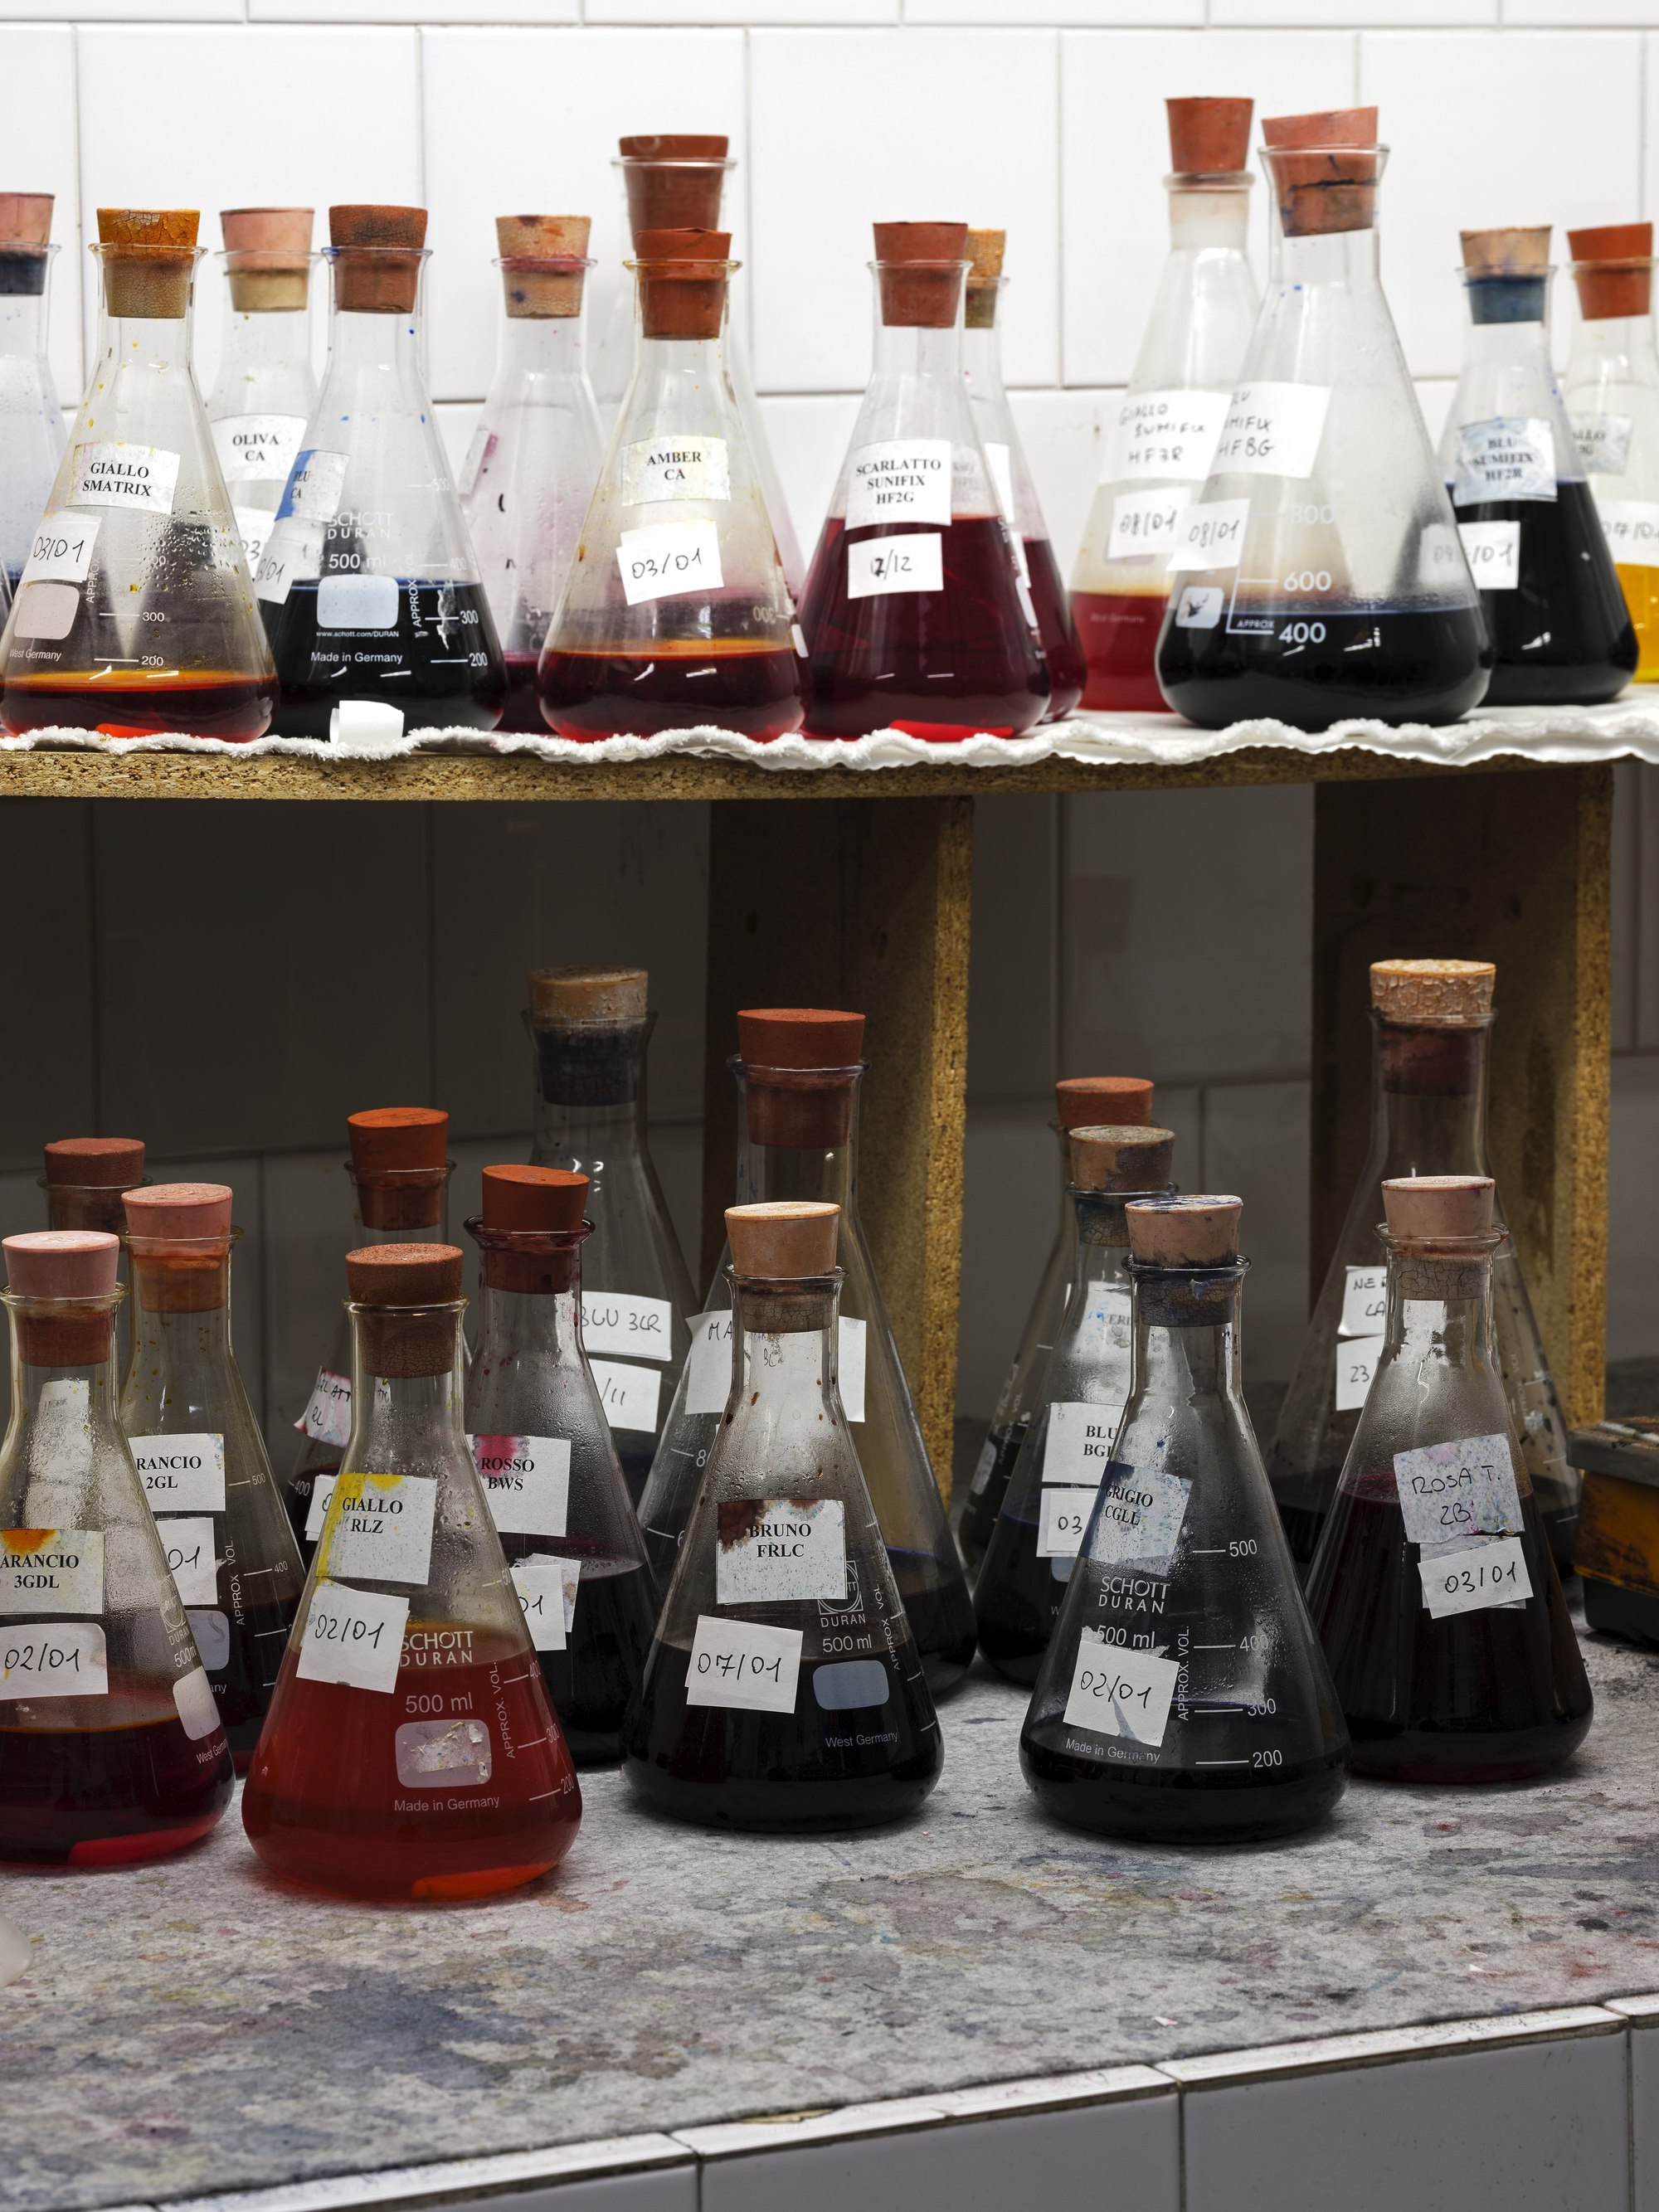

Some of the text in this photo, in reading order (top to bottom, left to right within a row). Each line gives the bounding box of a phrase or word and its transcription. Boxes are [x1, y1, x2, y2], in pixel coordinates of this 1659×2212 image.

[1120, 403, 1169, 425] GIALLO
[232, 434, 280, 446] OLIVA
[1487, 437, 1515, 449] BLU
[245, 450, 265, 462] CA
[646, 450, 703, 467] AMBER
[90, 462, 150, 479] GIALLO
[293, 470, 312, 483] BLU
[664, 468, 686, 481] CA
[855, 458, 942, 477] SCARLATTO
[82, 479, 153, 498] SMATRIX
[867, 474, 926, 490] SUNIFIX
[290, 488, 303, 499] CA
[875, 492, 915, 505] HF2G
[328, 512, 394, 527] SCHOTT
[1119, 509, 1178, 537] 08/01
[327, 527, 392, 540] DURAN
[1188, 519, 1241, 548] 08/01
[33, 537, 85, 563] 03/01
[328, 553, 387, 569] 500 ml
[450, 557, 468, 571] 400
[631, 547, 703, 579] 03/01
[85, 555, 101, 605] APPROX
[1282, 571, 1332, 592] 600
[407, 579, 422, 628] APPROX
[142, 611, 165, 622] 300
[460, 610, 479, 625] 300
[1236, 619, 1276, 630] APPROX
[316, 630, 399, 639] www.schott.com/DURAN
[1278, 622, 1327, 644] 400
[8, 649, 62, 661] West Germany
[141, 655, 164, 666] 200
[311, 652, 403, 664] Made in Germany
[469, 652, 488, 668] 200
[480, 1457, 536, 1473] ROSSO
[146, 1476, 179, 1490] 2GL
[251, 1473, 266, 1486] 500
[294, 1480, 311, 1496] 400
[487, 1476, 524, 1491] BWS
[1412, 1465, 1501, 1495] ROSA T.
[1106, 1484, 1154, 1508] GRIGIO
[342, 1497, 403, 1514] GIALLO
[1105, 1505, 1141, 1525] CGLL
[350, 1519, 384, 1534] RLZ
[749, 1523, 812, 1538] BRUNO
[1058, 1516, 1082, 1535] 03
[757, 1544, 805, 1558] FRLC
[1228, 1539, 1258, 1558] 500
[0, 1554, 80, 1569] ARANCIO
[274, 1559, 289, 1574] 400
[13, 1575, 60, 1588] 3GDL
[1444, 1561, 1517, 1593] 03/01
[1100, 1577, 1171, 1600] SCHOTT
[229, 1574, 246, 1626] APPROX
[1098, 1594, 1165, 1614] DURAN
[820, 1614, 867, 1628] DURAN
[314, 1614, 385, 1649] 02/01
[1097, 1625, 1155, 1649] 500 ml
[400, 1630, 474, 1652] SCHOTT
[822, 1634, 872, 1653] 500 ml
[881, 1618, 900, 1671] APPROX
[1178, 1626, 1190, 1657] VOL.
[1238, 1634, 1269, 1651] 400
[4, 1642, 80, 1672] 02/01
[174, 1649, 192, 1668] 500
[399, 1650, 474, 1668] DURAN
[528, 1659, 541, 1678] 400
[698, 1653, 781, 1682] 07/01
[489, 1661, 502, 1695] VOL.
[1080, 1670, 1152, 1709] 02/01
[1177, 1660, 1190, 1722] APPROX.
[405, 1692, 474, 1714] 500 ml
[1247, 1698, 1277, 1717] 300
[496, 1697, 516, 1759] APPROX.
[546, 1723, 560, 1743] 300
[825, 1732, 899, 1748] West Germany
[196, 1748, 214, 1766] West
[1065, 1738, 1161, 1764] Made in Germany
[1252, 1749, 1283, 1768] 200
[560, 1773, 575, 1796] 200
[394, 1795, 500, 1812] Made in Germany
